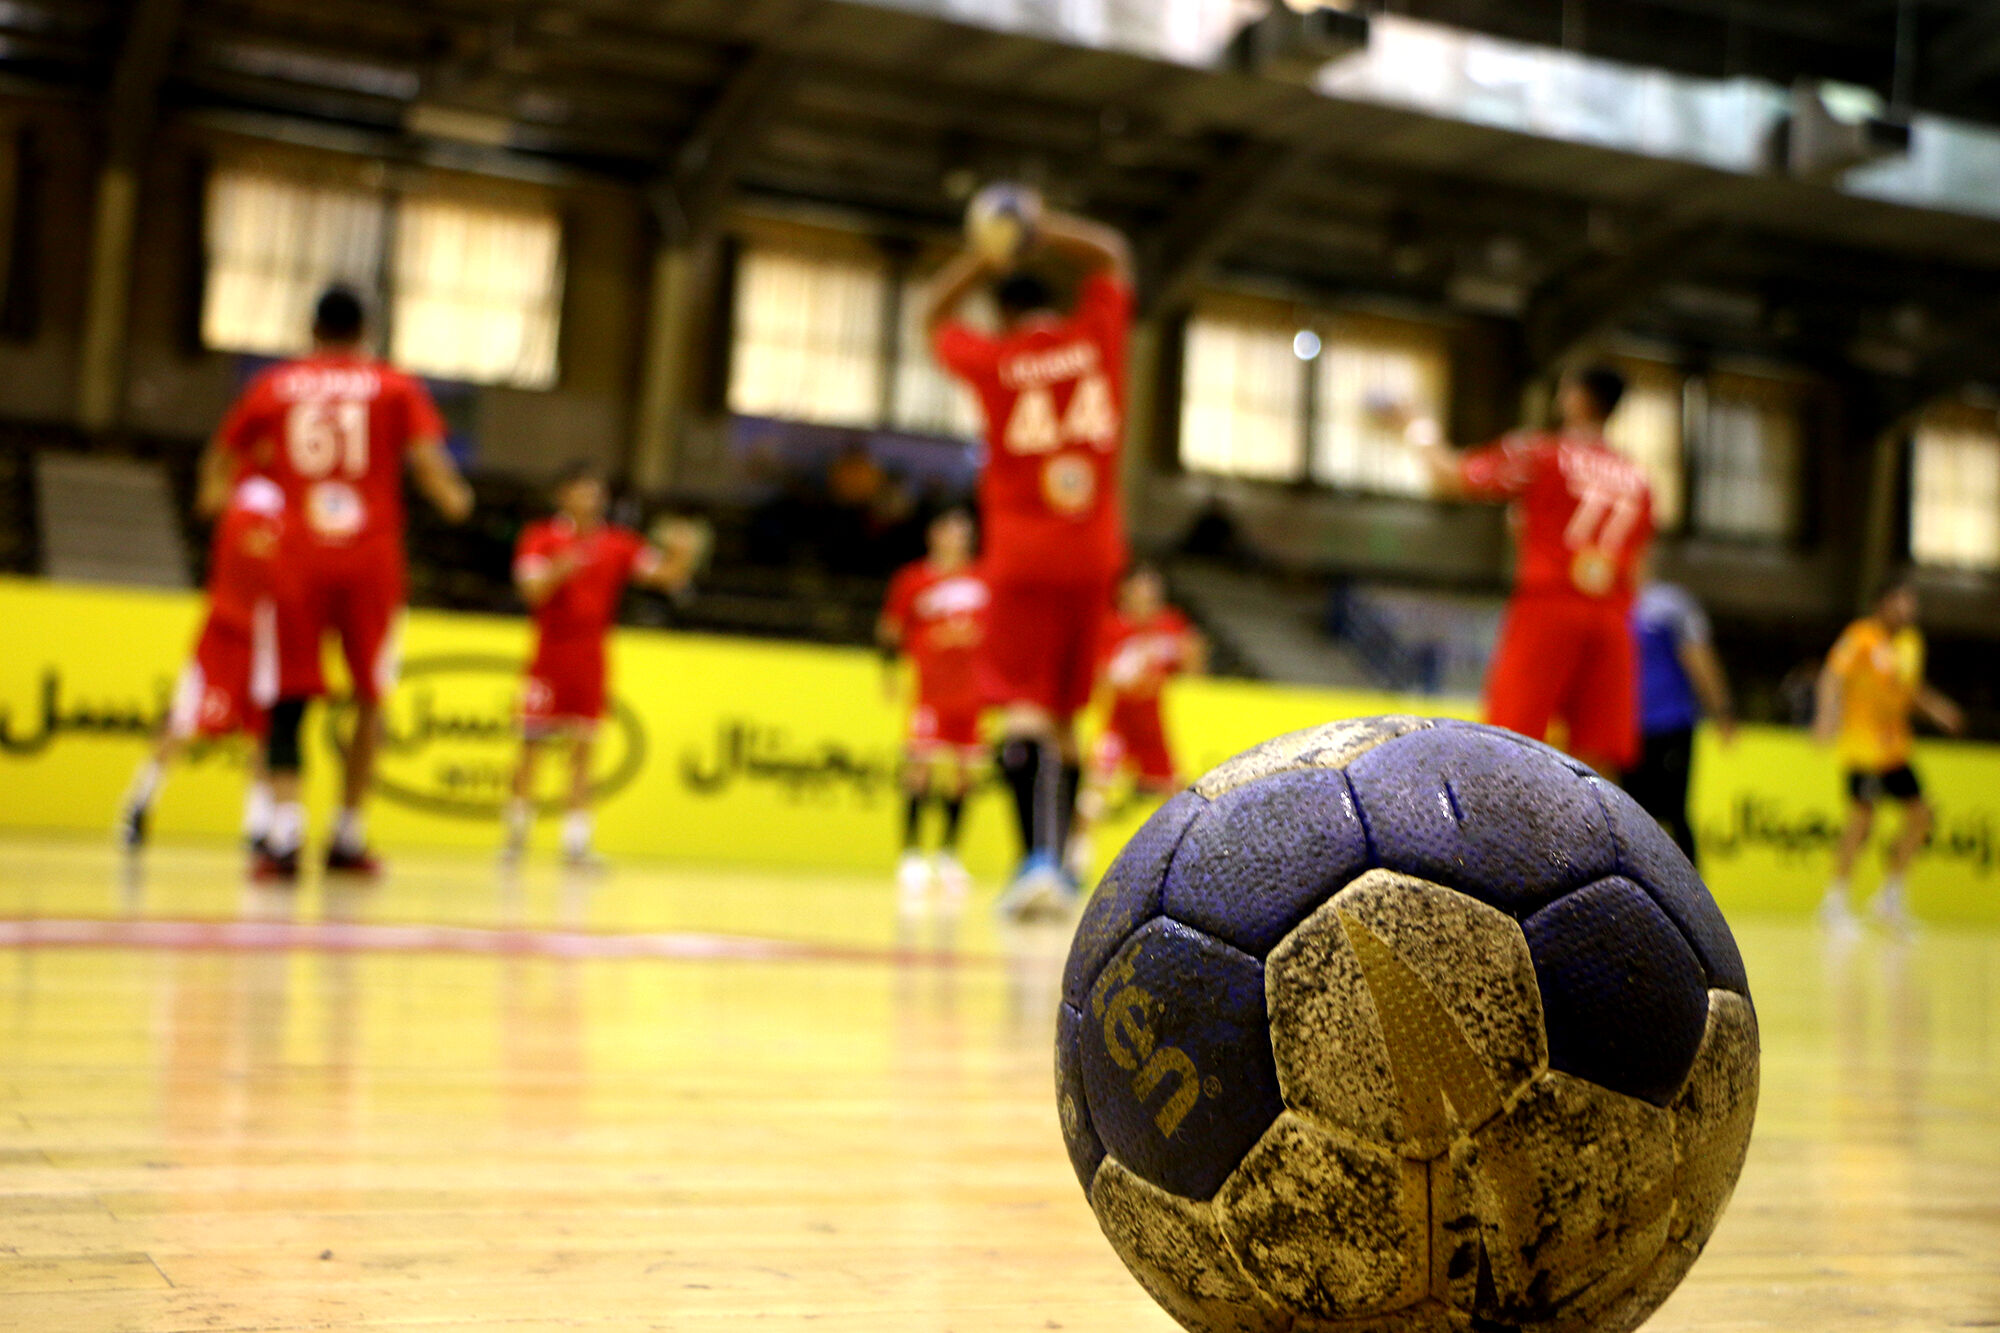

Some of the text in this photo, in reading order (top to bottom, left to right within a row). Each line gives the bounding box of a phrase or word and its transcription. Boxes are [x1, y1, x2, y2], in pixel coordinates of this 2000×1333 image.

[286, 400, 370, 479] 61
[1005, 373, 1118, 455] 44
[1563, 483, 1637, 555] 77
